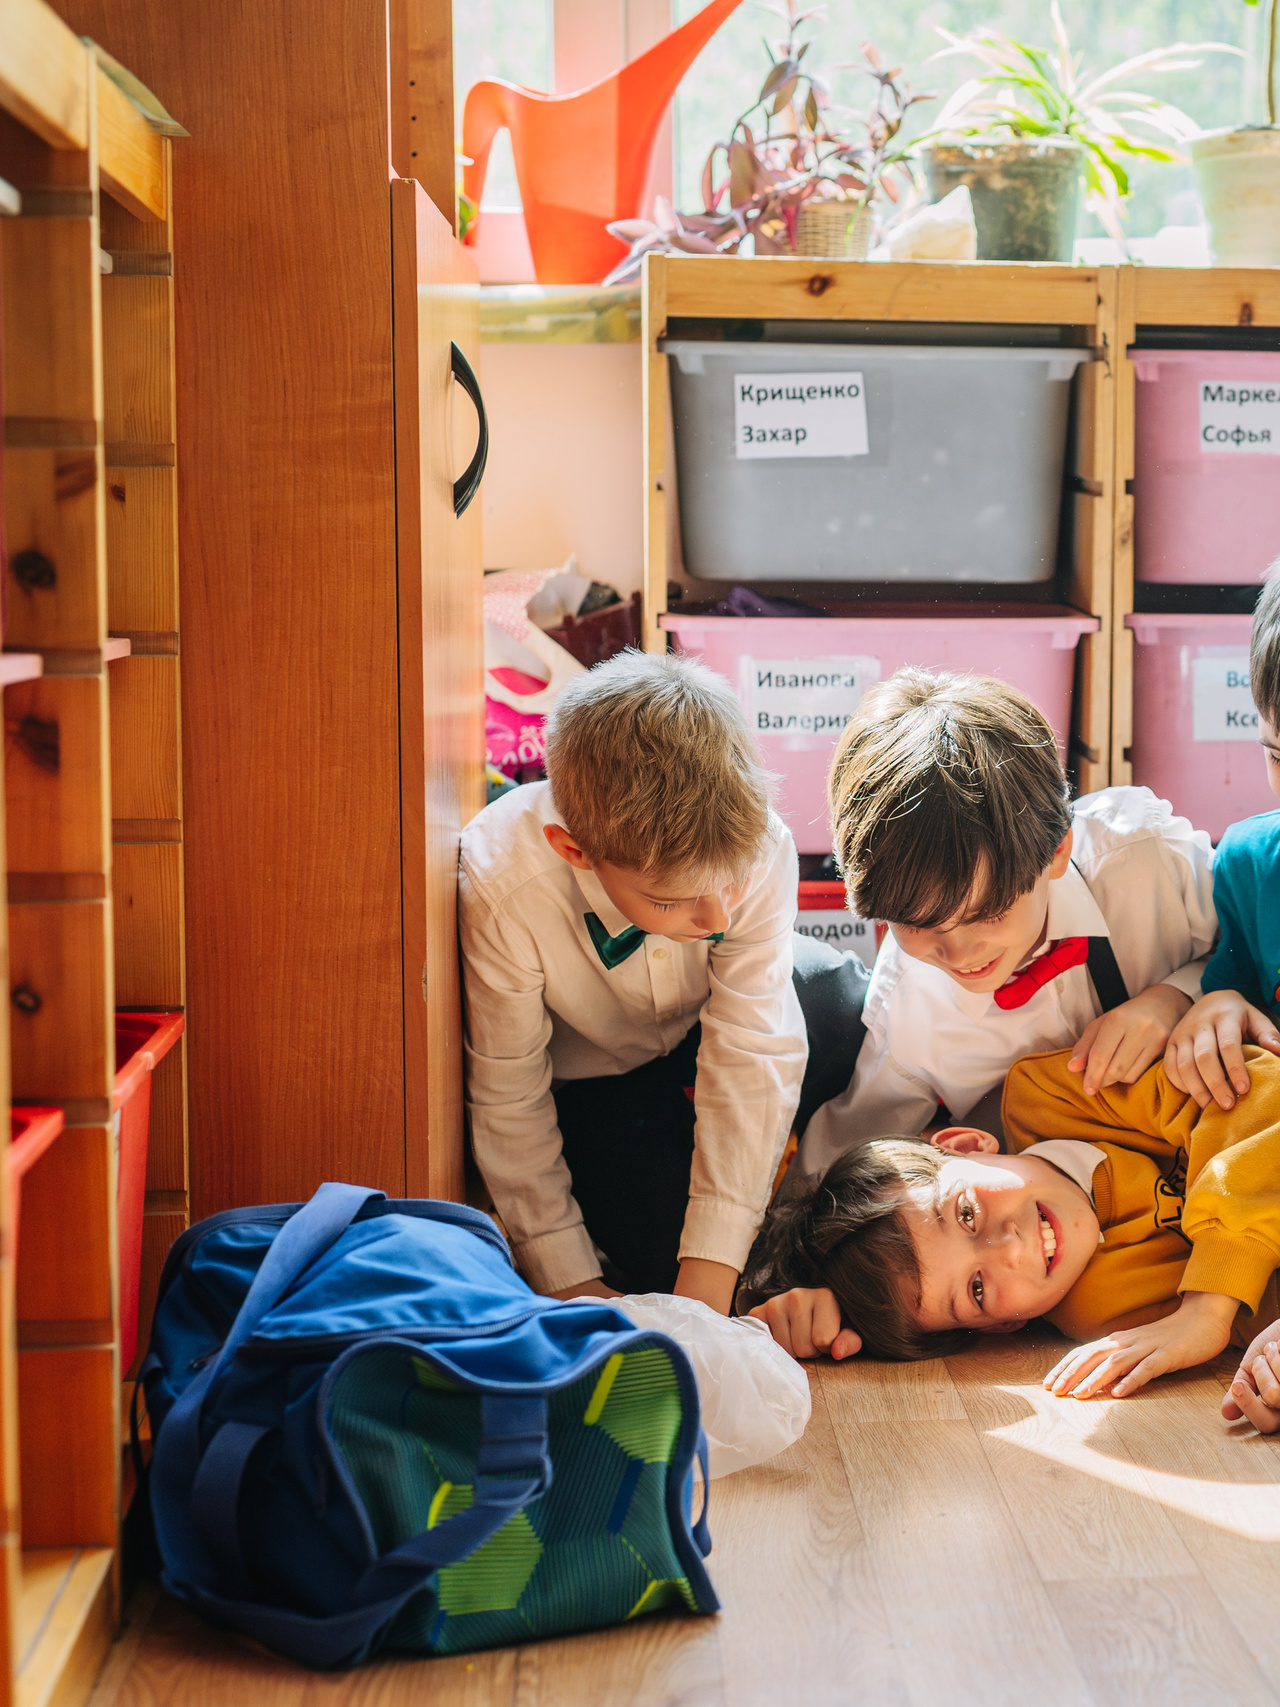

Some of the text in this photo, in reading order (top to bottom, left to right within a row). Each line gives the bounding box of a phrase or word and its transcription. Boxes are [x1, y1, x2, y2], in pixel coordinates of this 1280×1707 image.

[740, 383, 860, 406] Крищенко
[741, 425, 807, 446] Захар
[1202, 424, 1272, 446] Софья
[757, 671, 855, 688] Иванова
[794, 922, 866, 941] водов
